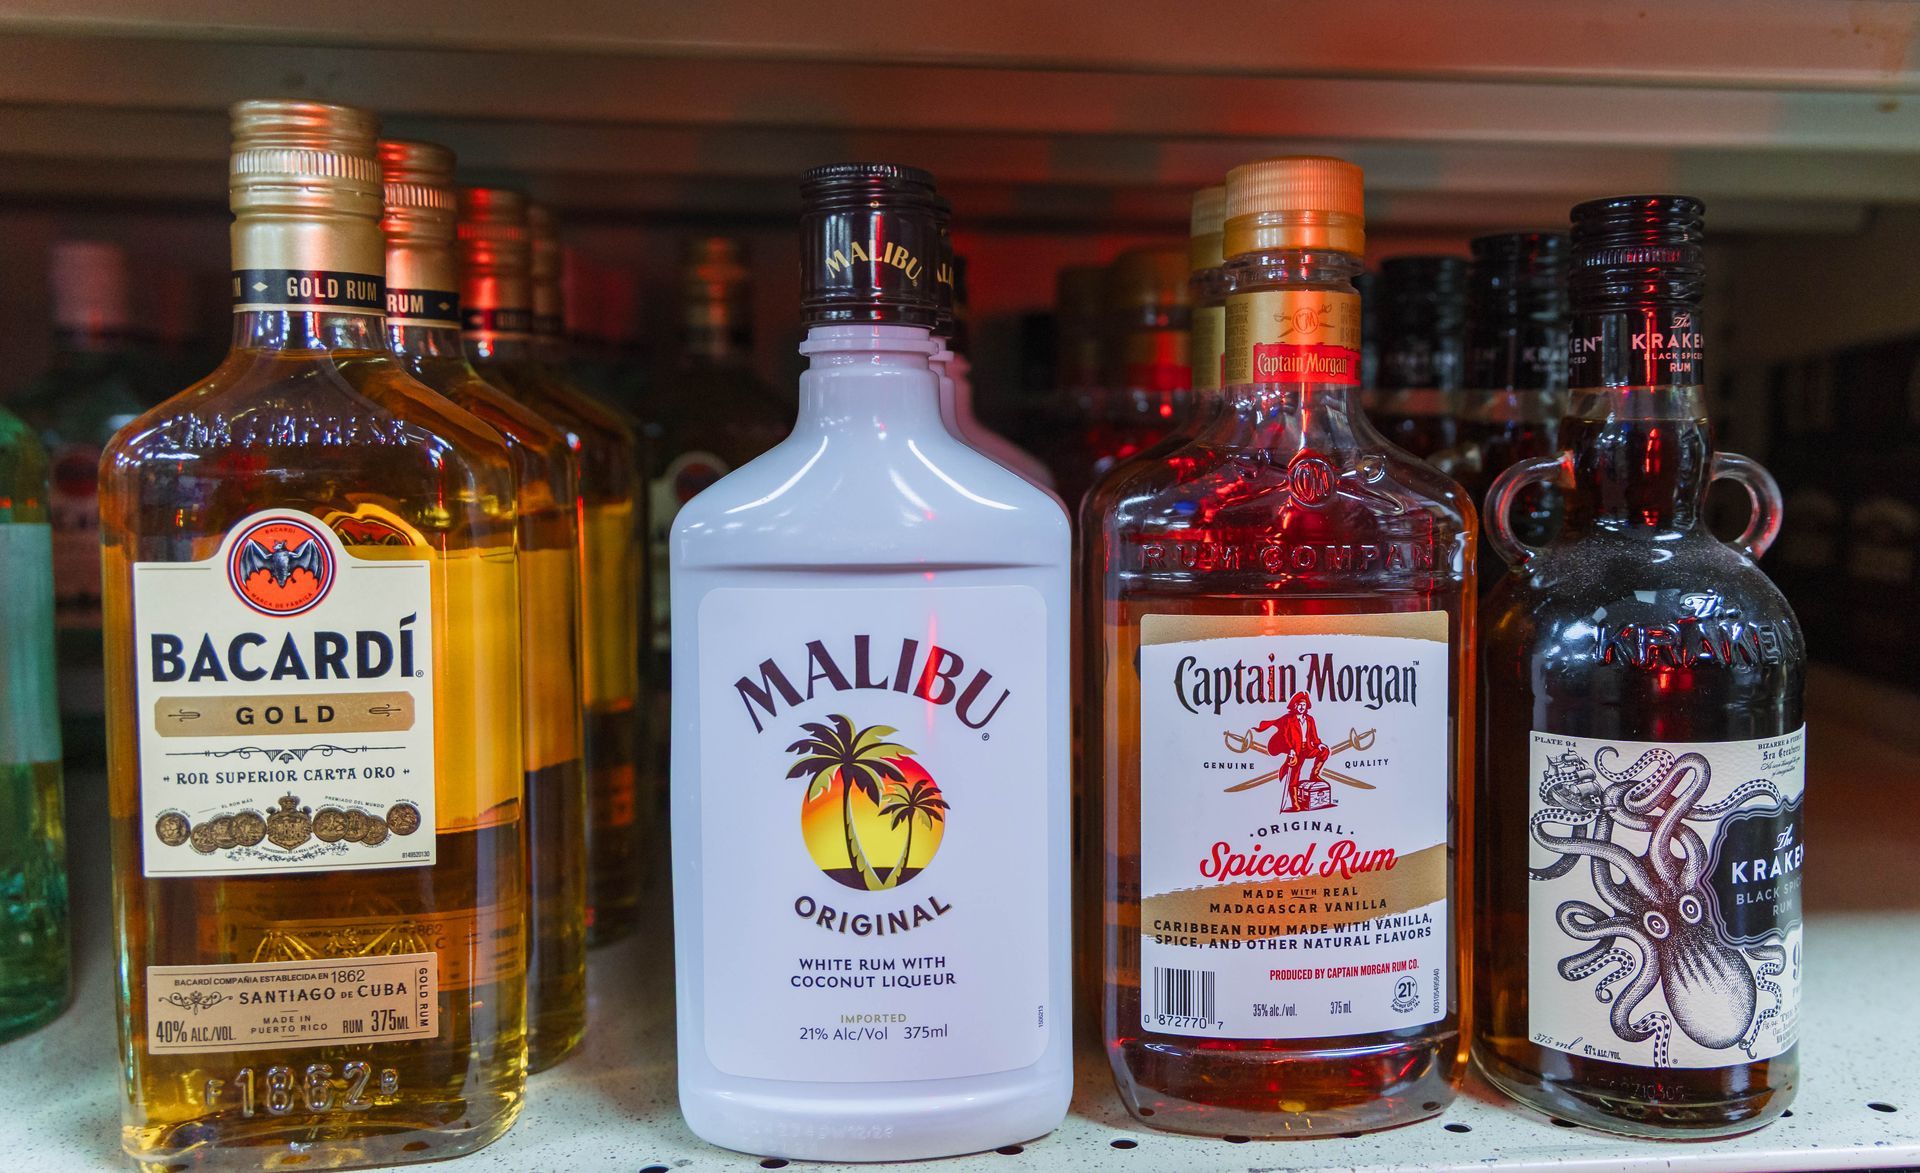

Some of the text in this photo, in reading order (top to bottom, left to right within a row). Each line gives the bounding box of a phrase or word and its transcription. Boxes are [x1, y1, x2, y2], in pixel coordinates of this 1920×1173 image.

[825, 239, 922, 279] MALIBU
[286, 277, 377, 301] GOLD RUM
[1257, 352, 1347, 377] Captain Morgan
[1644, 352, 1678, 360] BLACK
[1670, 363, 1691, 372] RUM
[151, 611, 417, 682] BACARDÍ
[733, 634, 1011, 734] MALIBU
[1173, 653, 1418, 715] Captain Morgan
[236, 705, 336, 725] GOLD
[1534, 736, 1564, 746] PLATE
[1758, 740, 1785, 750] BIZARRE
[1203, 759, 1389, 770] GENUINE QUALITY
[176, 766, 396, 785] RON SUPERIOR CARTA ORO
[1257, 821, 1343, 837] ORIGINAL
[1199, 840, 1398, 881] Spiced Rum
[1243, 886, 1358, 899] MADE WITH REAL
[1736, 887, 1780, 905] BLACK
[1210, 899, 1387, 914] MADAGASCAR VANILLA
[1772, 899, 1793, 916] RUM
[794, 895, 953, 937] ORIGINAL
[1153, 913, 1432, 936] CARIBBEAN RUM MADE WITH VANILLA,
[1155, 926, 1432, 950] SPICE, AND OTHER NATURAL FLAVORS
[799, 956, 946, 971] WHITE RUM WITH
[1269, 958, 1420, 981] PRODUCED BY CAPTAIN MORGAN RUM CO.
[260, 973, 316, 984] ESTABLECIDA
[318, 972, 329, 980] EN
[331, 969, 365, 984] 1862
[790, 973, 957, 989] COCONUT LIQUEUR
[239, 982, 407, 1005] SANTIAGO DE CUBA
[419, 968, 429, 1027] GOLD RUM
[841, 1013, 907, 1024] IMPORTED
[1253, 1003, 1297, 1017] 35% alc./vol.
[263, 1015, 311, 1024] MADE IN
[342, 1019, 364, 1033] RUM
[1143, 1014, 1150, 1024] 0
[1217, 1021, 1224, 1031] 7
[156, 1021, 237, 1043] 40% ALC./VOL.
[251, 1023, 328, 1034] PUERTO RICO
[800, 1024, 948, 1041] 21% Alc/Vol 375ml
[1534, 1032, 1583, 1050] 375 ml
[234, 1061, 374, 1118] 1862
